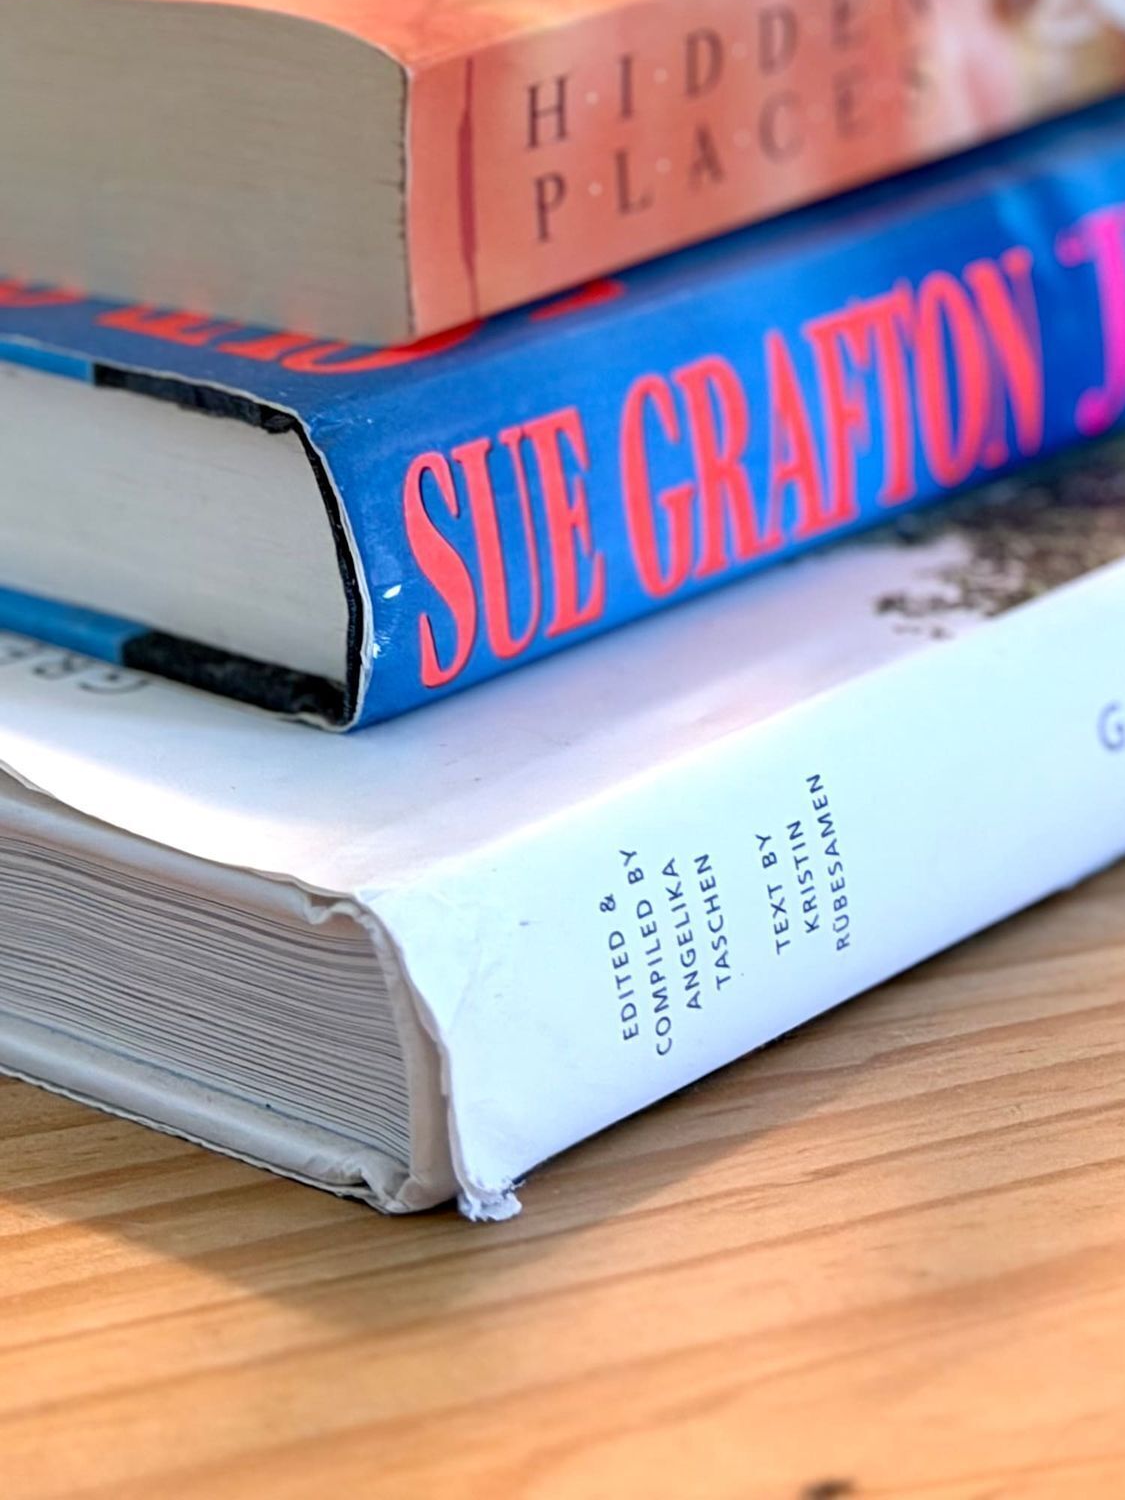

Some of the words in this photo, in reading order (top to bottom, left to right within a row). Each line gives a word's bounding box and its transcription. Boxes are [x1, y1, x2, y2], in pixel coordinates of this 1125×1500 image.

[403, 406, 605, 689] SUE
[619, 247, 1044, 598] GRAFTON
[599, 894, 617, 913] &
[619, 848, 645, 884] BY
[755, 832, 779, 869] BY
[785, 819, 820, 934] KRISTIN
[661, 857, 703, 1010] ANGELIKA
[693, 853, 732, 991] TASCHEN
[767, 881, 792, 955] TEXT
[608, 930, 640, 1041] EDITED
[635, 898, 673, 1056] COMPILED
